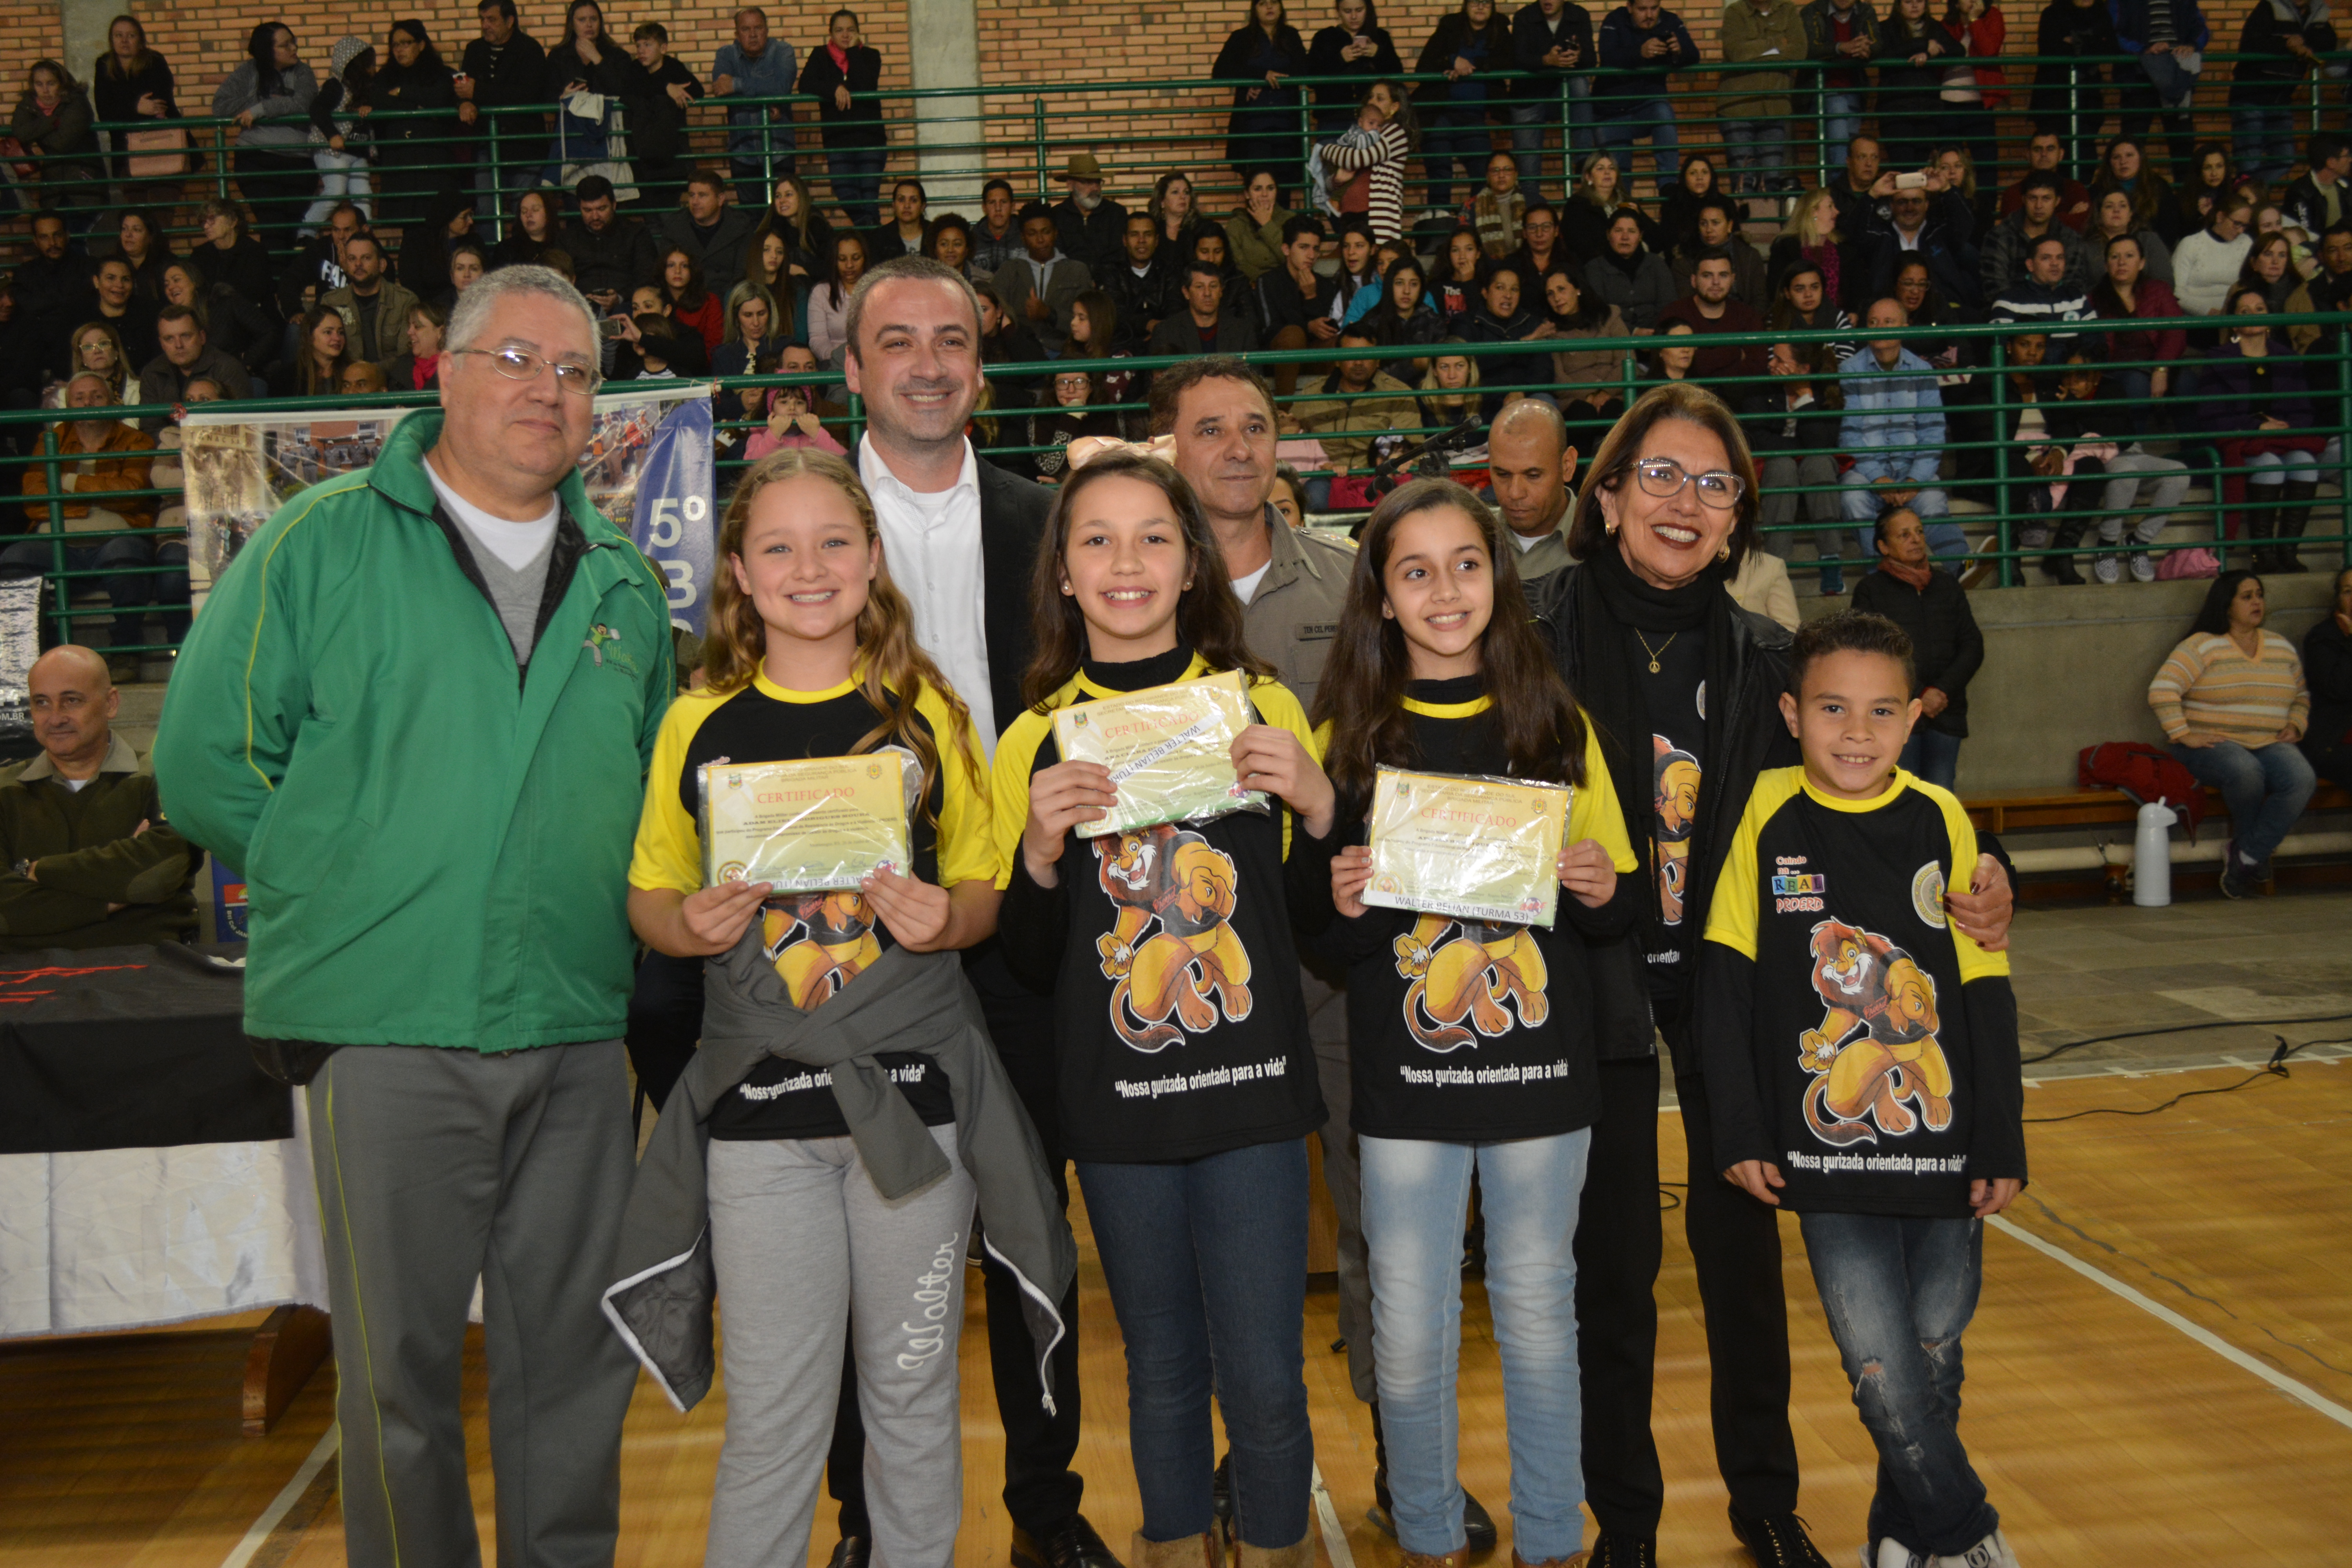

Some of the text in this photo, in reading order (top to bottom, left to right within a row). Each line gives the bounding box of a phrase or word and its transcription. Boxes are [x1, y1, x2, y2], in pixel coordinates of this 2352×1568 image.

[1105, 711, 1199, 739] CERTIFICADO
[1164, 725, 1200, 750] WALTER
[1134, 748, 1165, 769] BELIAN
[757, 787, 855, 804] CERTIFICADO
[1421, 808, 1516, 828] CERTIFICADO
[1776, 855, 1806, 866] Caindo
[833, 877, 862, 886] ALTER
[1774, 877, 1823, 893] REAL
[1916, 865, 1939, 886] BRIGAD
[1395, 896, 1528, 922] WALTER BELIAN (TURMA 53)
[1776, 897, 1824, 913] PROERD
[1925, 911, 1945, 923] GRAND
[1647, 949, 1680, 964] orienta
[770, 1071, 813, 1100] gurizada
[1151, 1073, 1187, 1099] gurizada
[1189, 1065, 1230, 1090] orientada
[1232, 1065, 1254, 1086] para
[1256, 1063, 1263, 1078] a
[1435, 1065, 1474, 1087] gurizada
[1476, 1063, 1519, 1083] orientada
[1522, 1064, 1543, 1085] para
[1545, 1064, 1551, 1078] a
[1823, 1152, 1864, 1173] gurizada
[1866, 1153, 1912, 1171] orientada
[1915, 1156, 1936, 1175] para
[1939, 1158, 1945, 1171] a
[897, 1232, 958, 1370] Walter
